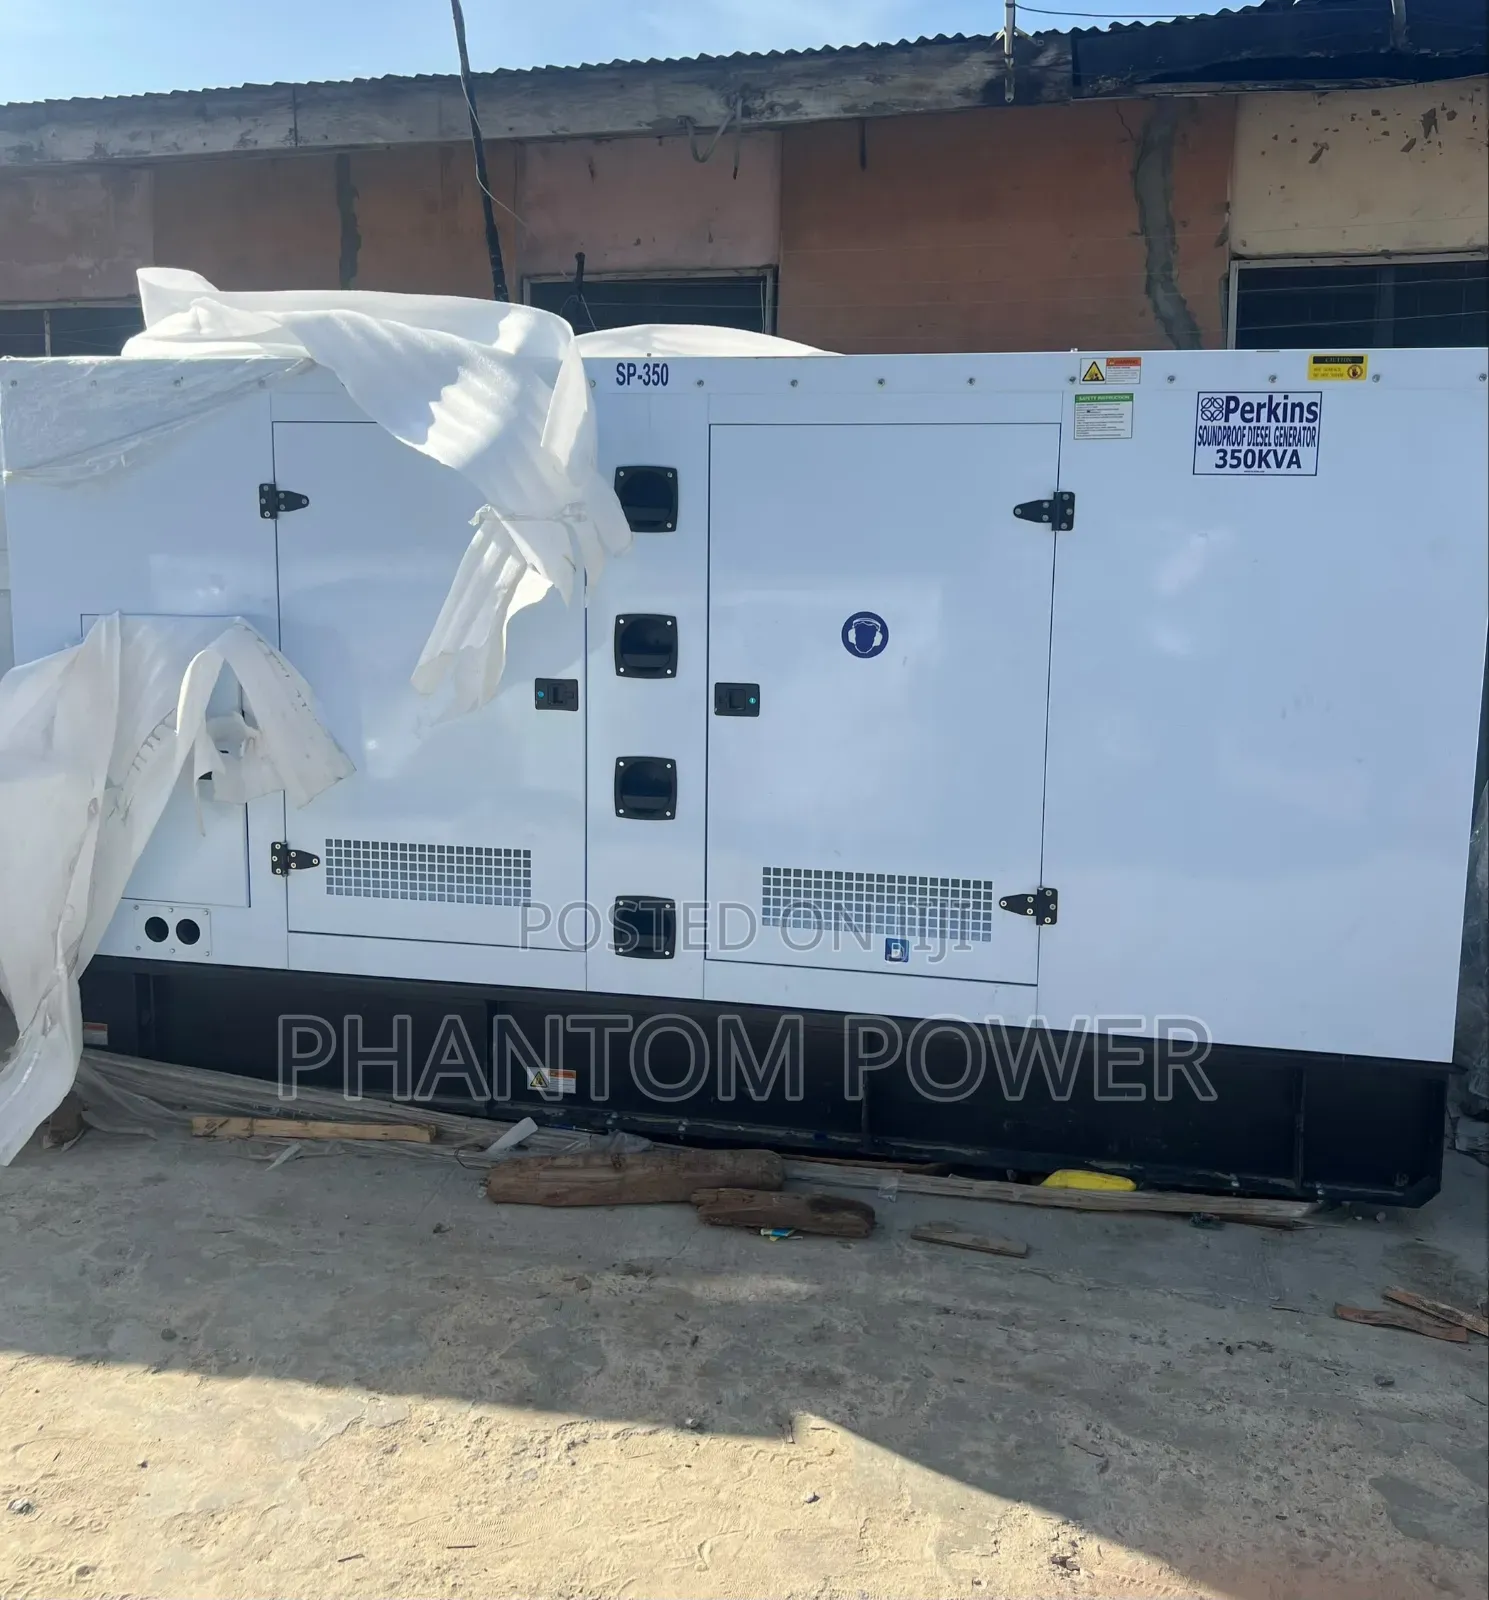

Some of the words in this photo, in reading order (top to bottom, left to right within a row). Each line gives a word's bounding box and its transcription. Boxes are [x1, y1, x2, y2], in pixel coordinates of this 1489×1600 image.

[616, 362, 669, 386] SP-350
[1224, 394, 1319, 424] Perkins
[1197, 425, 1247, 447] SOUNDPROOF
[1247, 425, 1272, 447] DIESEL
[1273, 425, 1317, 448] GENERATOR
[1214, 448, 1302, 470] 350KVA
